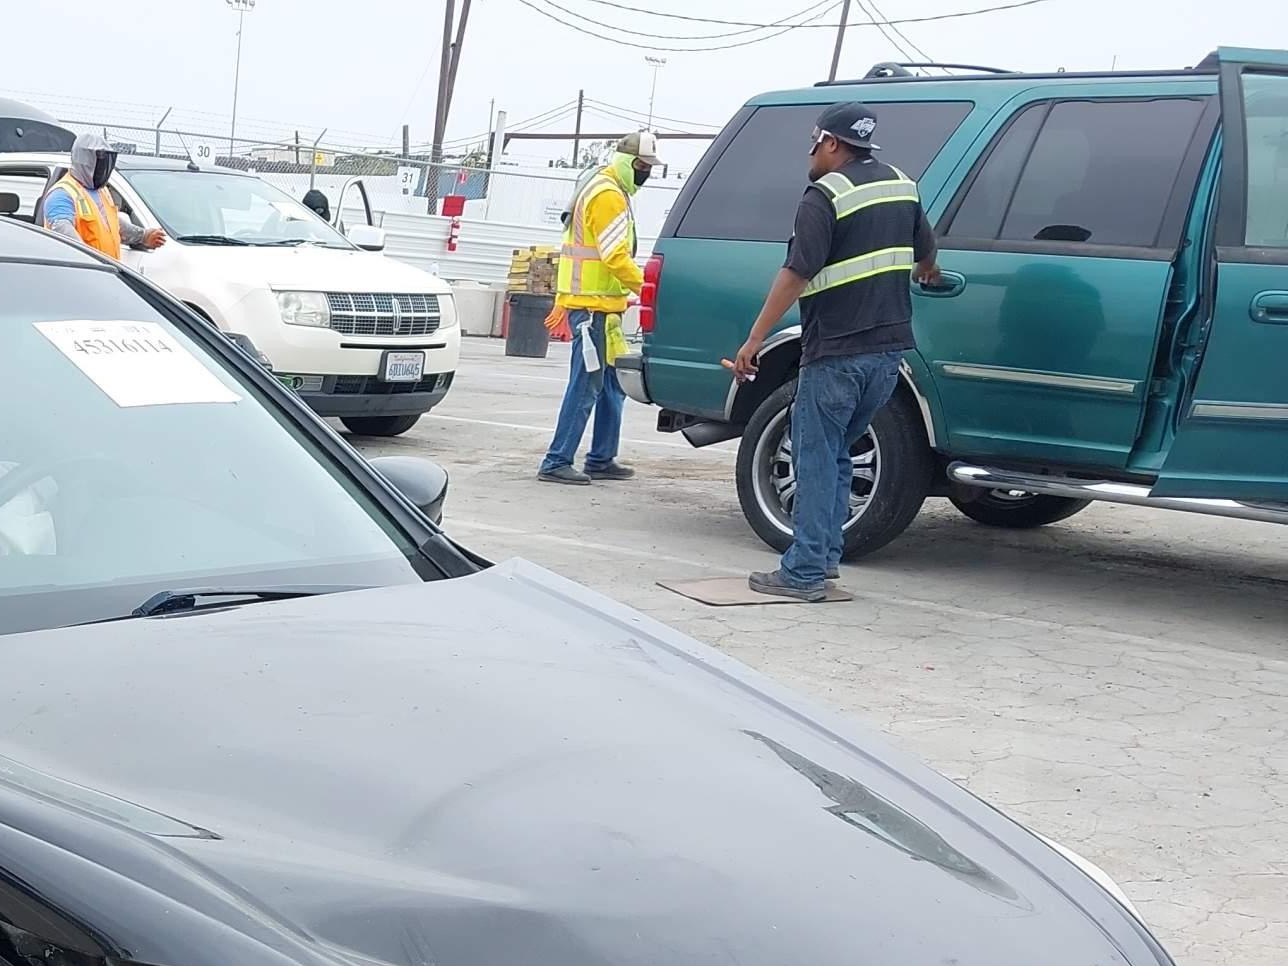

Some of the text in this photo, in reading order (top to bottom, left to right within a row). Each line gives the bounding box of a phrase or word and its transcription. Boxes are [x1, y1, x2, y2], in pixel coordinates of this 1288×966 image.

[196, 145, 211, 158] 30
[401, 172, 414, 184] 31
[72, 338, 174, 355] 45316114
